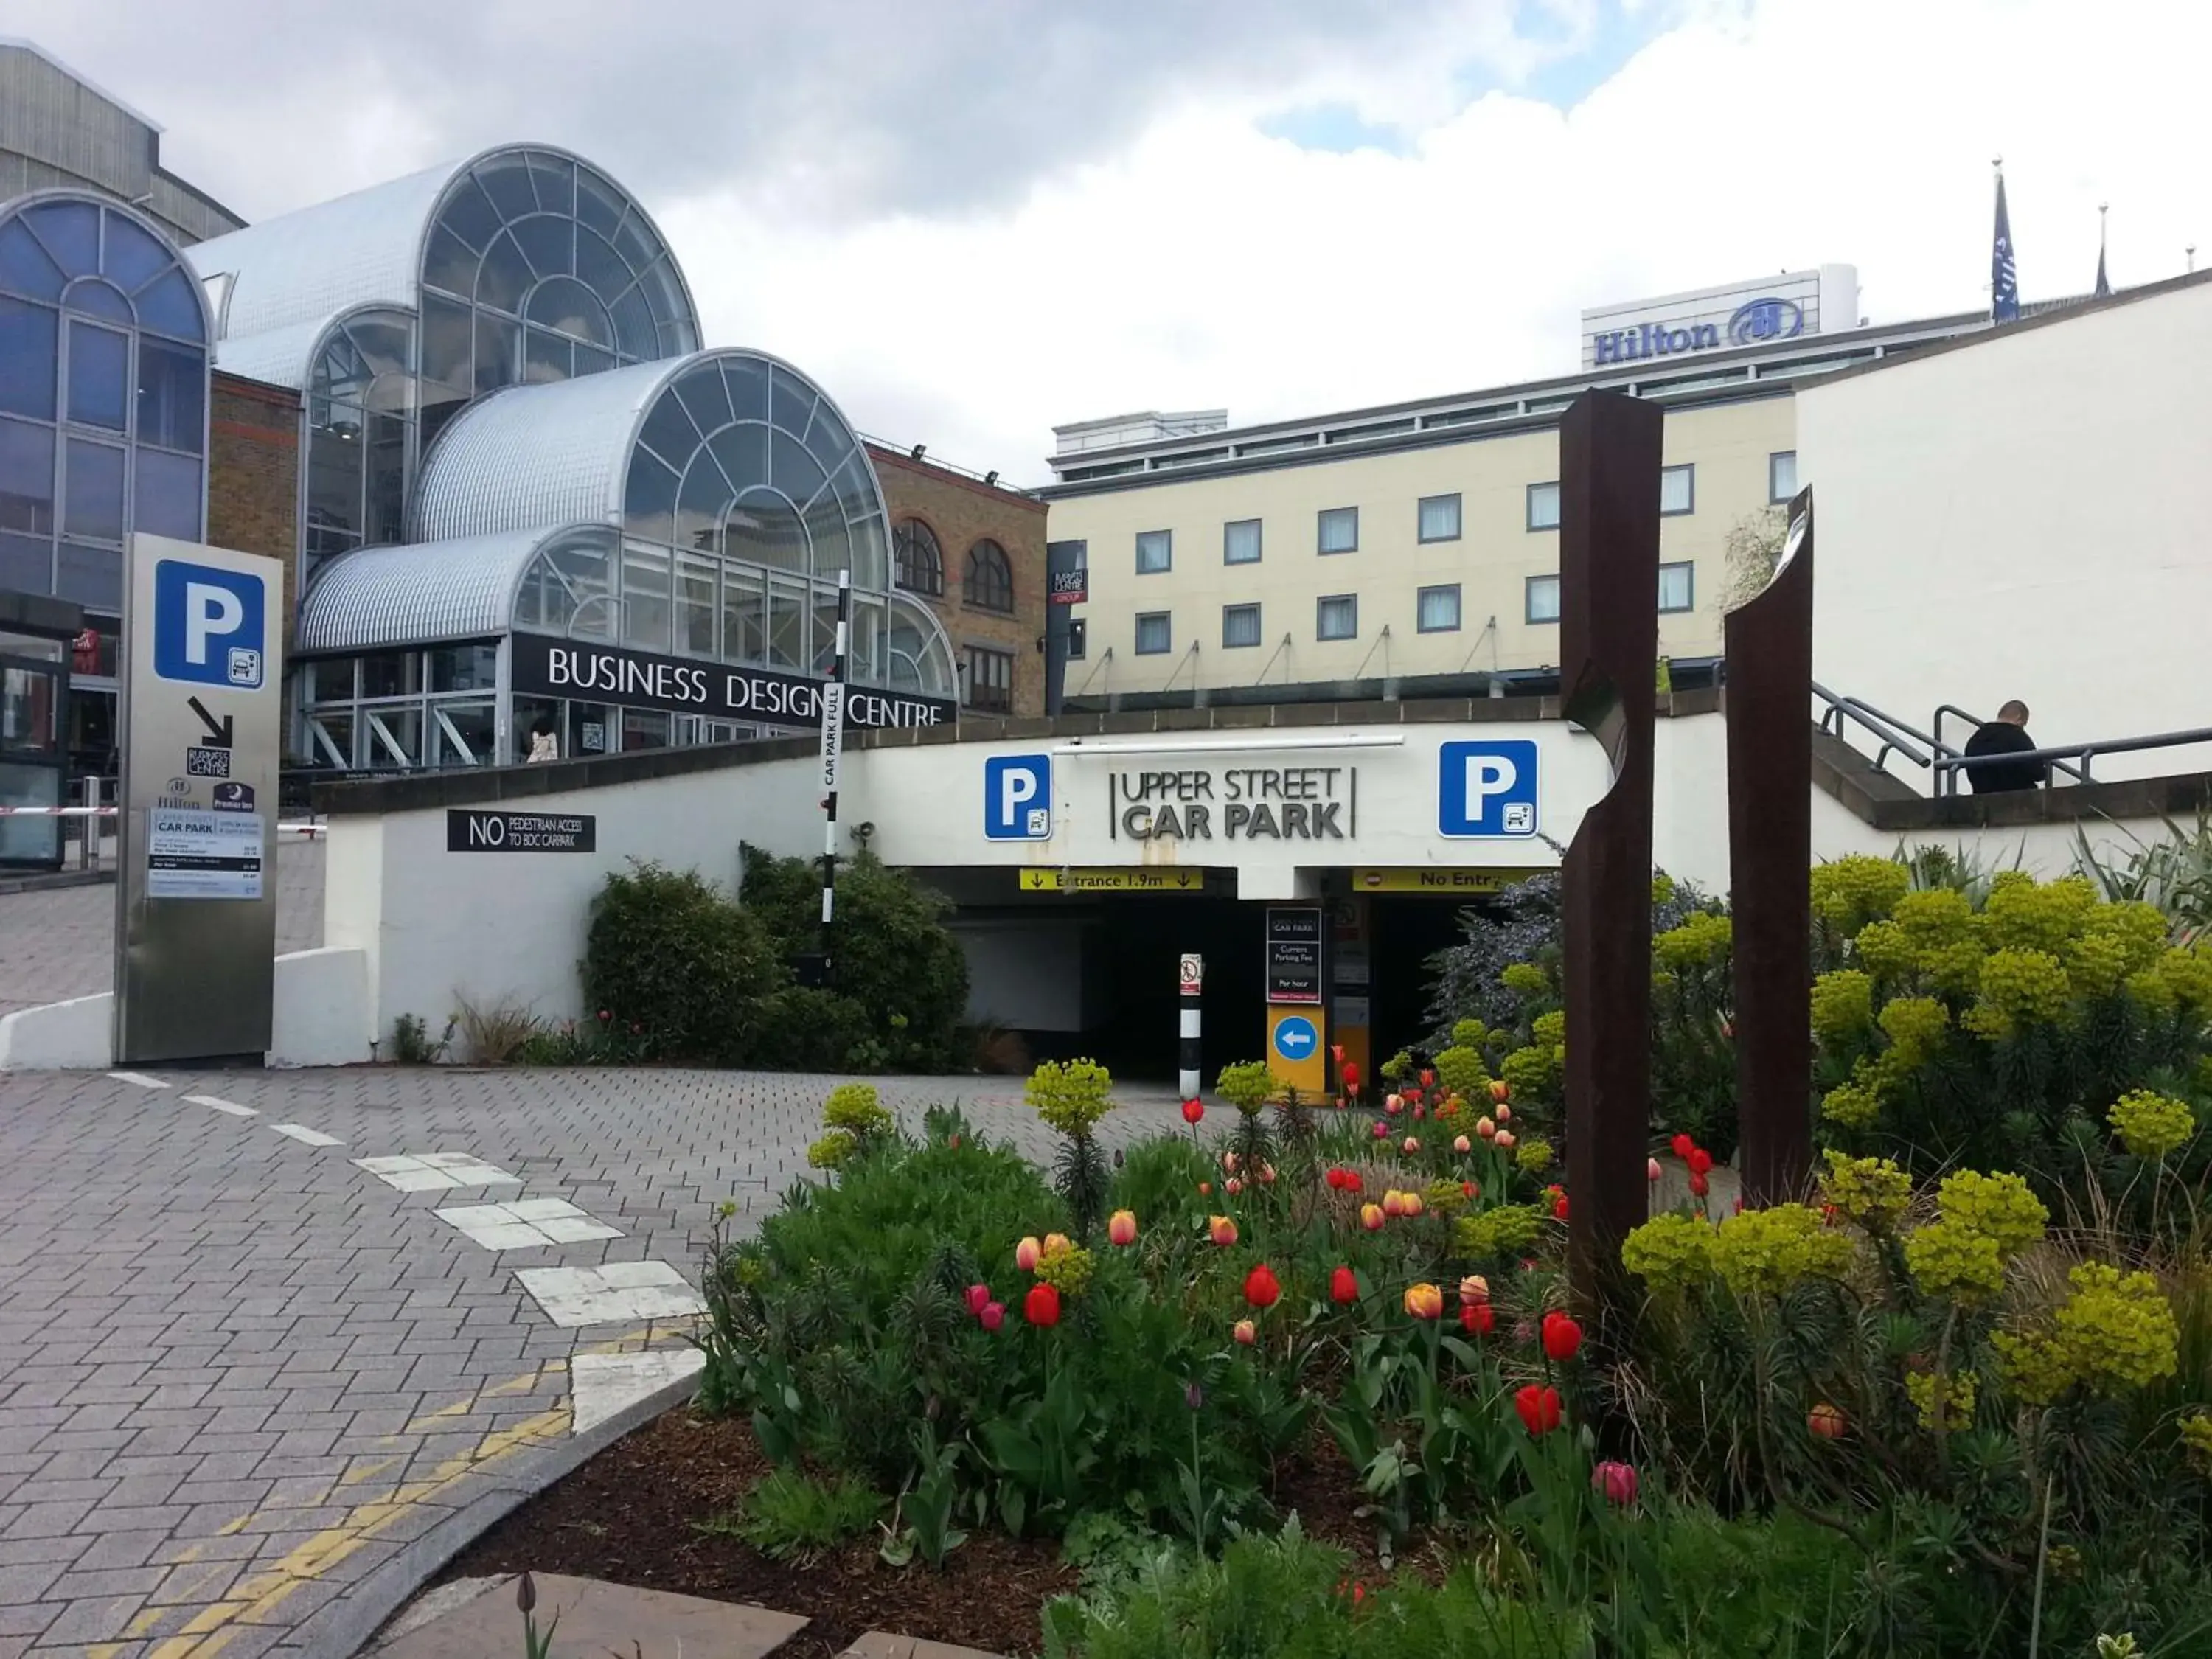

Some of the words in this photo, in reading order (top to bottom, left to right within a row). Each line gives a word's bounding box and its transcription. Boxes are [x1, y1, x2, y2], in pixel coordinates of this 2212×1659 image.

[1593, 323, 1719, 364] Hilton
[186, 581, 243, 664] P
[549, 647, 706, 703] BUSINESS
[726, 675, 824, 717] DESIGN
[848, 694, 942, 728] CENTRE
[827, 689, 838, 720] FULL
[826, 723, 836, 756] PARK
[825, 759, 834, 785] CAR
[1121, 771, 1214, 801] UPPER
[1225, 768, 1341, 799] STREET
[158, 796, 200, 810] Hilton
[1003, 768, 1037, 826] P
[1465, 755, 1517, 821] P
[159, 822, 182, 832] CAR
[185, 824, 213, 833] PARK
[470, 815, 504, 846] NO
[509, 817, 556, 831] PEDESTRIAN
[557, 819, 582, 832] ACCESS
[1121, 804, 1212, 840] CAR
[1225, 802, 1343, 839] PARK
[509, 833, 521, 846] TO
[523, 834, 540, 846] BDC
[1056, 874, 1121, 887] Etrance
[1128, 873, 1163, 887] 1.9m
[1421, 872, 1446, 886] No
[1276, 954, 1299, 962] Parking
